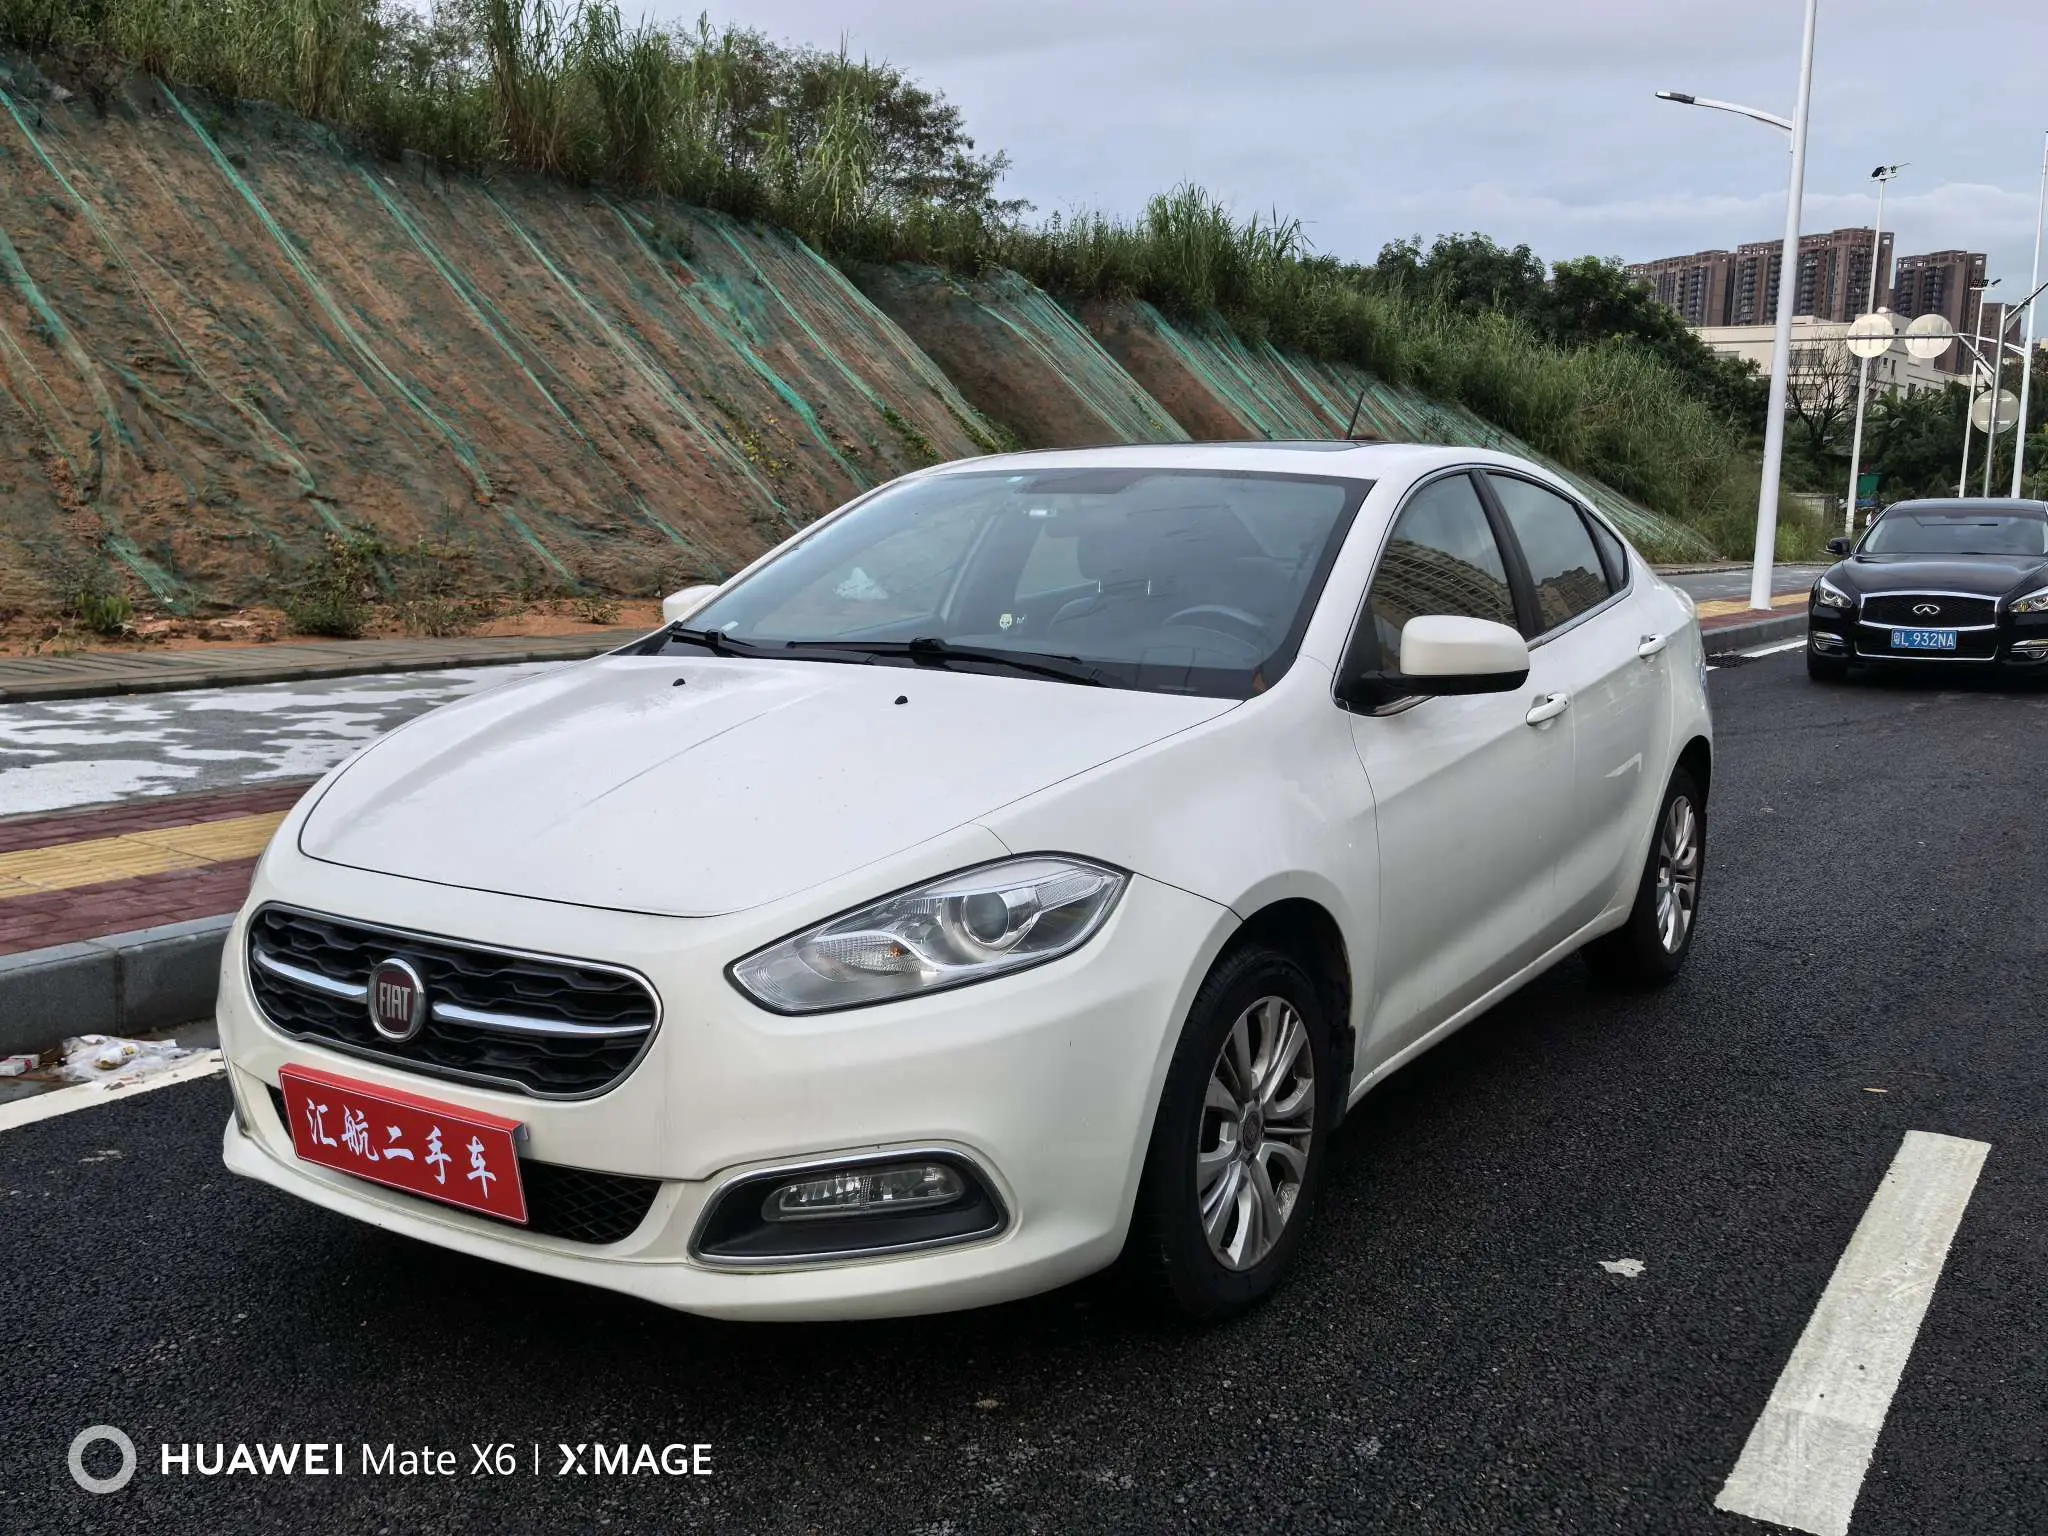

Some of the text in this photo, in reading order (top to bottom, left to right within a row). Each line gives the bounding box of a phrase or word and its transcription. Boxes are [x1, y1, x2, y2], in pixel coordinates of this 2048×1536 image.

[380, 982, 411, 1021] FIAT
[306, 1097, 497, 1199] 汇航二手车
